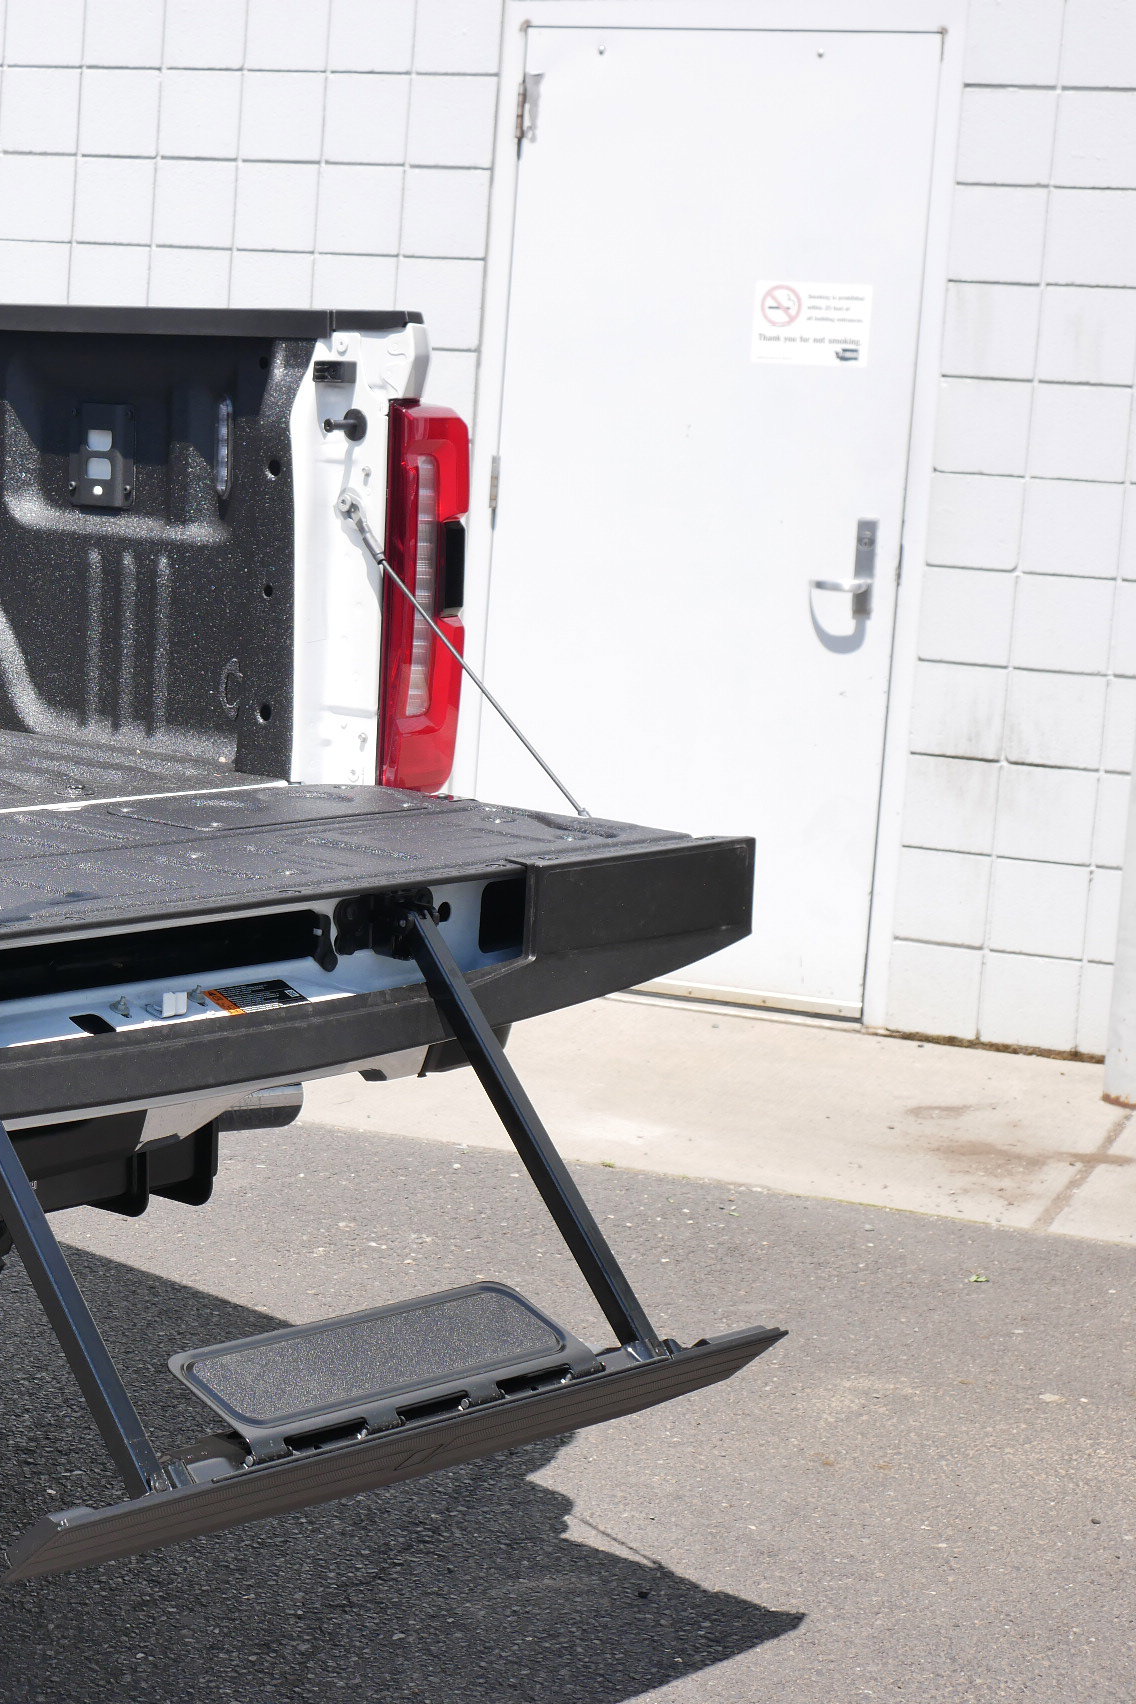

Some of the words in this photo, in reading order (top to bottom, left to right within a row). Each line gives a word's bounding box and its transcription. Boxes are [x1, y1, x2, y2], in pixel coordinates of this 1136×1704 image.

[758, 333, 781, 342] Thank
[784, 335, 797, 344] you
[799, 335, 810, 343] for
[813, 336, 826, 344] not
